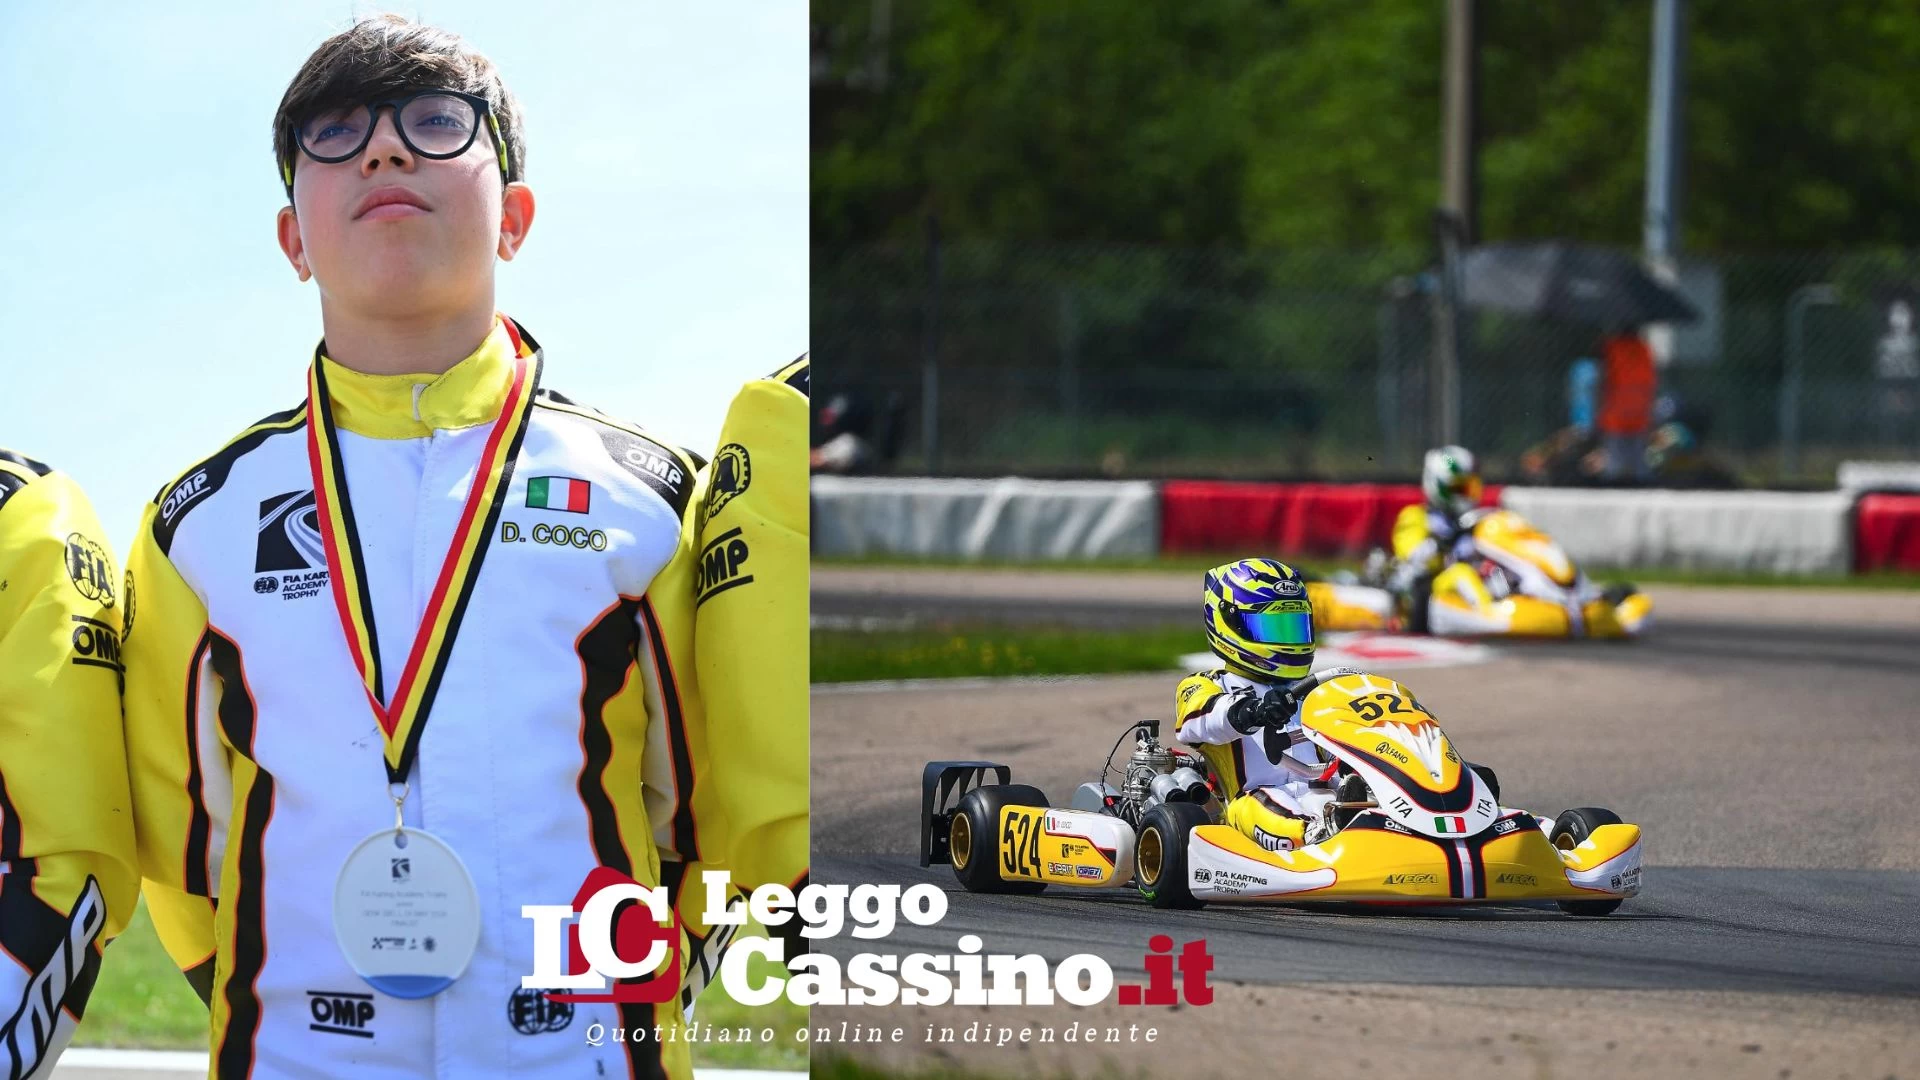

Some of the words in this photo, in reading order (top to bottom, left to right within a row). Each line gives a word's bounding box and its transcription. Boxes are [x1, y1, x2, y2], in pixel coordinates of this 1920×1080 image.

[626, 448, 682, 484] OMP
[162, 472, 208, 520] OMP
[501, 522, 526, 542] D.
[533, 524, 607, 551] COCO
[69, 542, 113, 598] FIA
[283, 575, 301, 583] FIA
[304, 571, 330, 581] KART
[282, 580, 328, 592] ACADEMY
[282, 589, 319, 600] TROPHY
[1376, 741, 1408, 764] ALFANO
[1389, 796, 1413, 819] ITA
[1476, 798, 1492, 818] ITA
[1494, 820, 1517, 833] OMP
[1003, 811, 1043, 879] 524
[1195, 871, 1210, 881] FIA
[1230, 873, 1268, 885] KARTING
[1390, 873, 1439, 885] VEGA
[1500, 873, 1538, 886] VEGA
[1213, 879, 1248, 889] ACADEMY
[1213, 885, 1241, 895] TROPHY
[311, 997, 375, 1028] OMP
